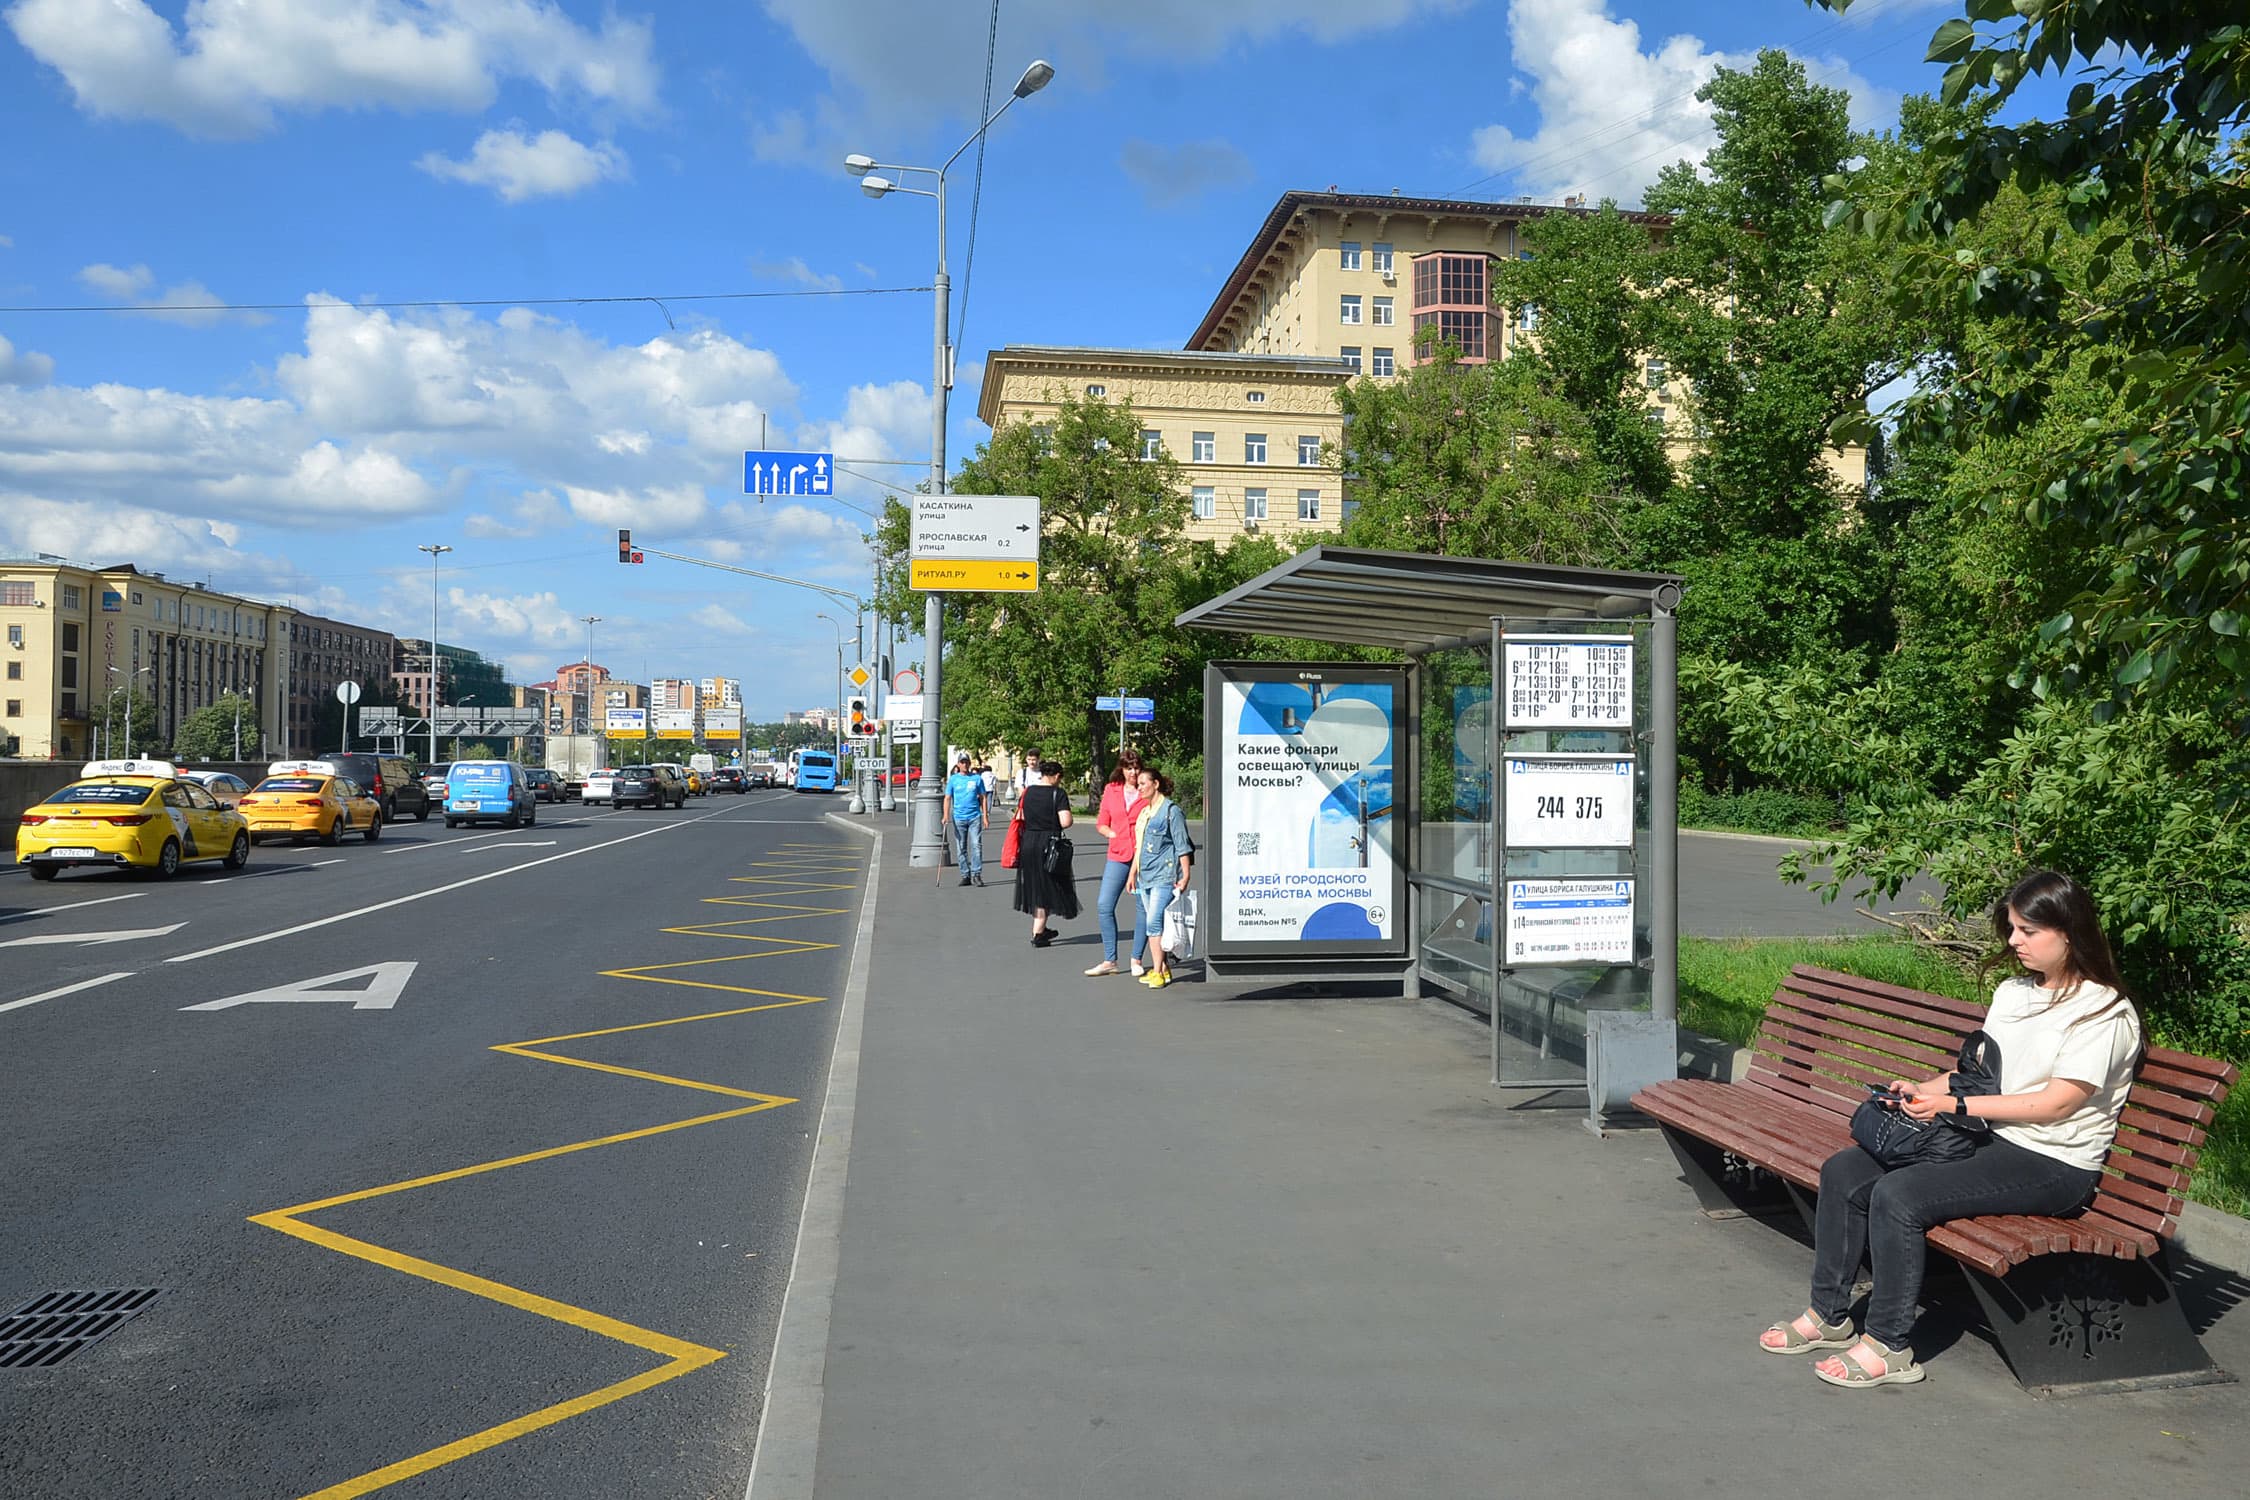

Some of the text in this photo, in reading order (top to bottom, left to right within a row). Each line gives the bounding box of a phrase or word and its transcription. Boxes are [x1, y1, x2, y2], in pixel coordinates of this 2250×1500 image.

[919, 501, 973, 511] КАСАТКИНА
[919, 513, 946, 521] улица
[919, 532, 987, 542] ЯРОСЛАВСКАЯ
[918, 543, 945, 552] улица
[998, 539, 1010, 548] 0.2
[917, 570, 1010, 579] РИТУАЛ.РУ 1.0
[1529, 647, 1539, 659] 10
[1550, 647, 1560, 659] 17
[1587, 648, 1598, 660] 10
[1608, 648, 1618, 660] 15
[1513, 661, 1518, 673] 6
[1529, 661, 1539, 674] 12
[1549, 661, 1560, 674] 18
[1587, 662, 1596, 675] 11
[1608, 663, 1618, 675] 16
[1513, 675, 1518, 688] 7
[1529, 676, 1539, 688] 13
[1550, 676, 1560, 688] 19
[1572, 676, 1577, 688] 6
[1587, 677, 1597, 689] 12
[1608, 677, 1618, 689] 17
[1513, 690, 1518, 702] 8
[1529, 690, 1539, 703] 14
[1549, 690, 1560, 703] 20
[1572, 691, 1577, 703] 7
[1587, 691, 1598, 703] 13
[1608, 691, 1618, 704] 18
[1513, 704, 1518, 717] 9
[1528, 704, 1539, 717] 16
[1572, 705, 1577, 718] 8
[1587, 705, 1597, 718] 14
[1607, 706, 1618, 718] 20
[1238, 743, 1338, 757] Какие фонари
[1238, 761, 1360, 773] освещают улицы
[1527, 762, 1548, 770] УЛИЦА
[1549, 762, 1575, 770] БОРИСА
[1576, 762, 1613, 770] ГАЛУШКИНА
[1238, 776, 1303, 787] Москвы?
[1538, 796, 1602, 819] 244 375
[1239, 873, 1367, 885] МУЗЕЙ ГОРОДСКОГО
[1239, 887, 1372, 899] ХОЗЯЙСТВА МОСКВЫ
[1514, 885, 1525, 897] А
[1527, 886, 1548, 894] УЛИЦА
[1550, 885, 1574, 893] БОРИСА
[1575, 884, 1613, 893] ГАЛУШКИНА
[1617, 883, 1628, 895] А
[1238, 908, 1266, 917] ВДНХ,
[1371, 910, 1383, 919] 6+
[1238, 917, 1297, 927] павильон №5
[1515, 942, 1524, 955] 93
